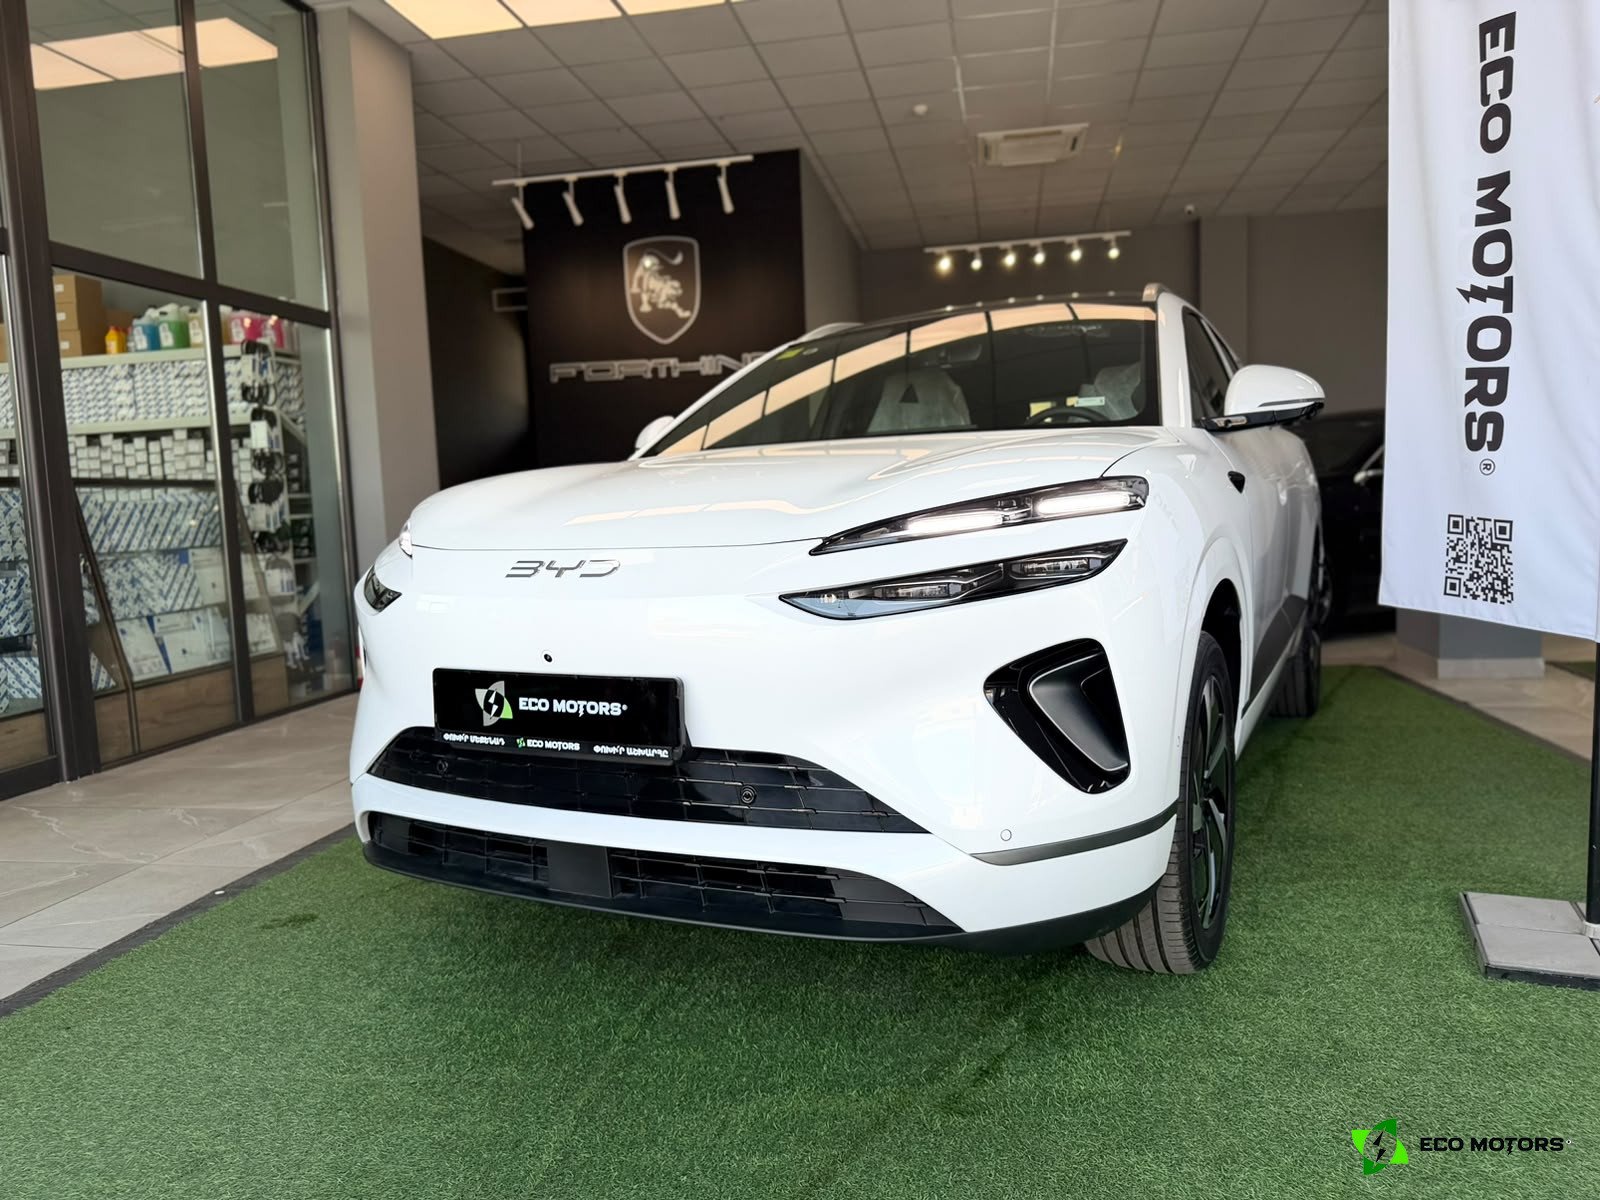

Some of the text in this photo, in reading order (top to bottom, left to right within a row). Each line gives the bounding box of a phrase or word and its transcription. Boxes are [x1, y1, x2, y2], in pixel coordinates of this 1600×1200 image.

[1478, 11, 1517, 154] ECO
[549, 351, 768, 384] FORTHIN
[505, 559, 621, 578] BYD
[518, 696, 550, 712] ECO
[526, 738, 581, 752] ECO MOTORS
